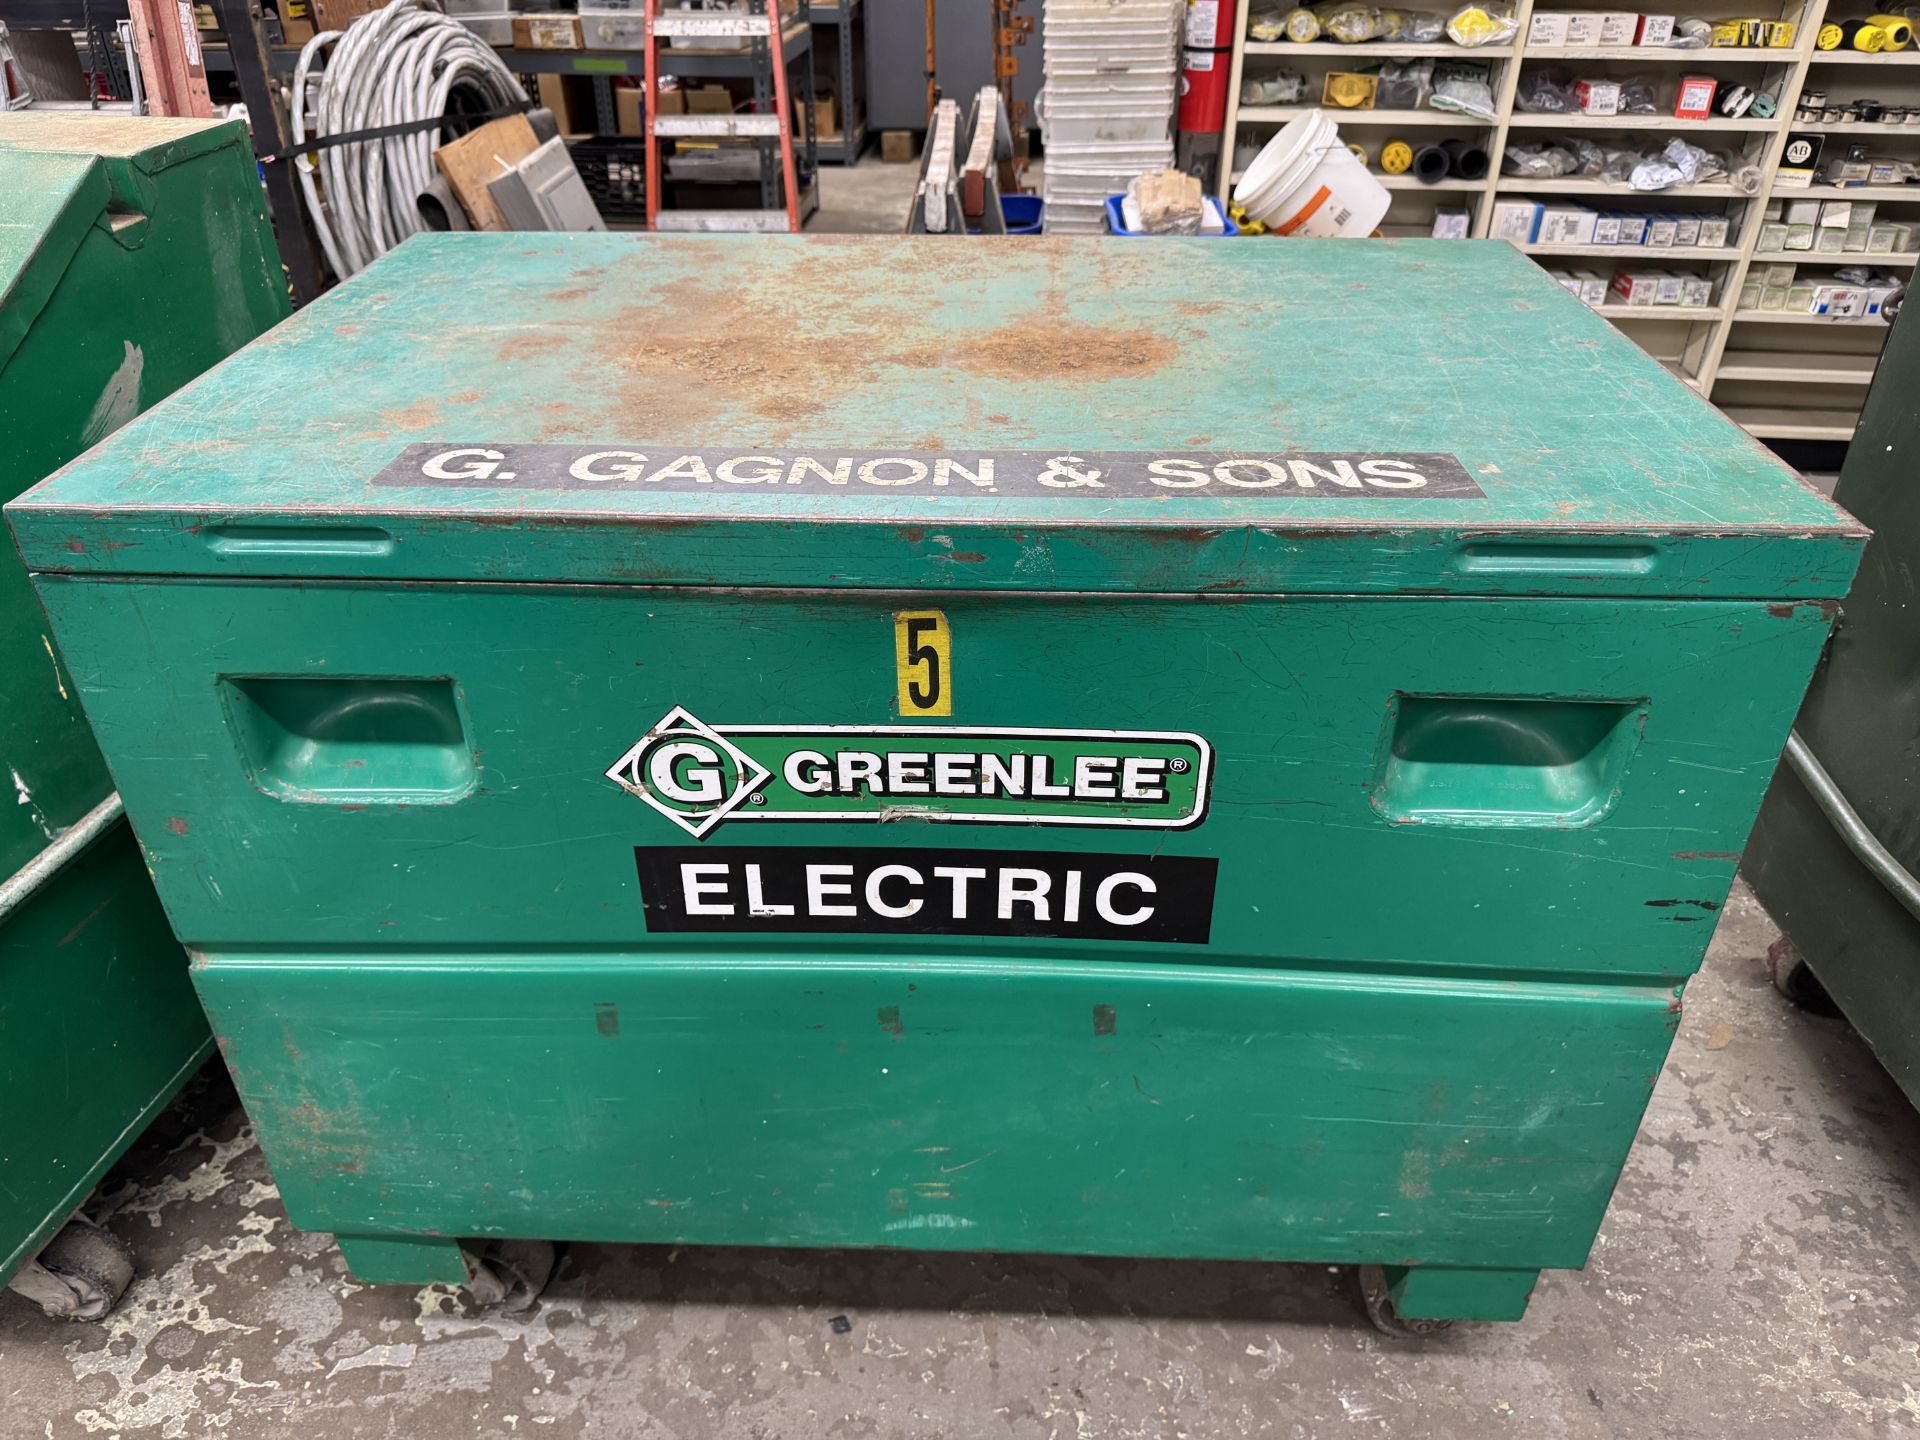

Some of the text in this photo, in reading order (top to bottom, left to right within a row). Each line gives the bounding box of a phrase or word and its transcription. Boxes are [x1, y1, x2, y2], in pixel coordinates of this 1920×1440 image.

[421, 448, 1429, 490] G. GAGNON & SONS
[907, 617, 941, 709] 5
[680, 863, 1157, 926] ELECTRIC
